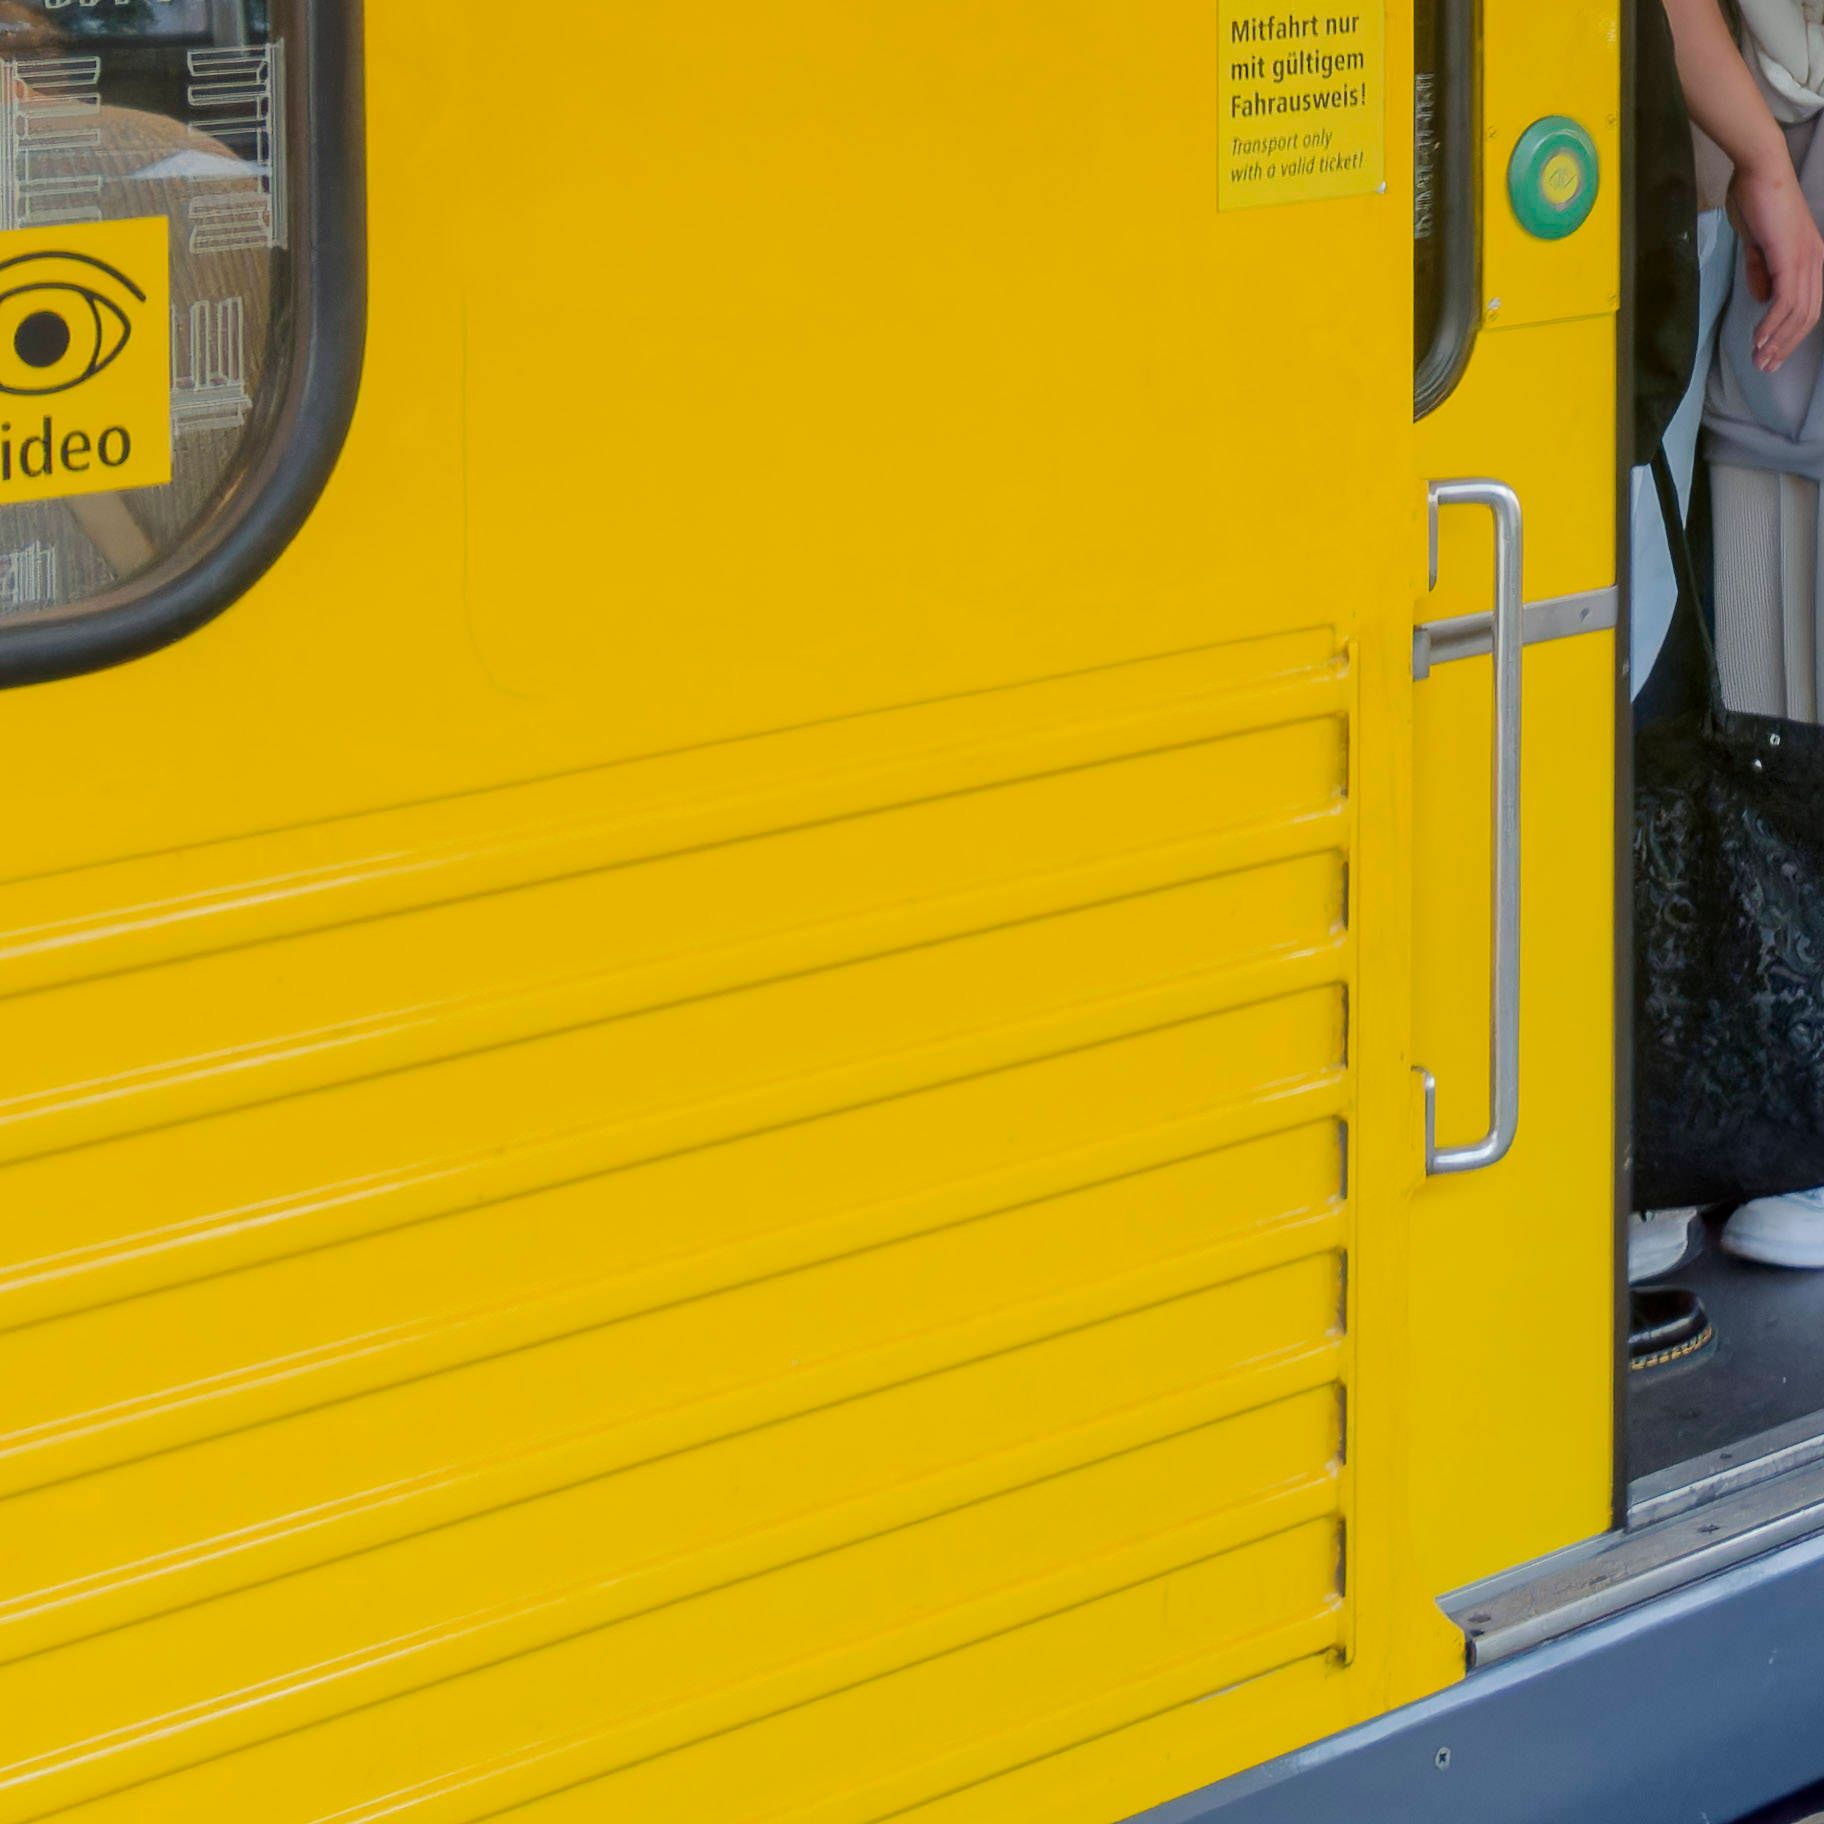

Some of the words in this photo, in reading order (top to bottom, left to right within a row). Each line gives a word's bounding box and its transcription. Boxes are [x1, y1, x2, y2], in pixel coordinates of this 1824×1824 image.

[1231, 14, 1319, 44] Mitfahrt
[1326, 15, 1360, 36] nur
[1231, 55, 1265, 81] mit
[1272, 49, 1364, 83] gültigem
[1231, 82, 1366, 119] Fahrausweis!
[1231, 133, 1299, 156] Transport
[1302, 127, 1333, 151] only
[1230, 161, 1263, 183] with
[1266, 163, 1276, 179] a
[1280, 155, 1316, 177] valid
[1319, 150, 1364, 174] ticket!
[1, 415, 131, 481] ideo
